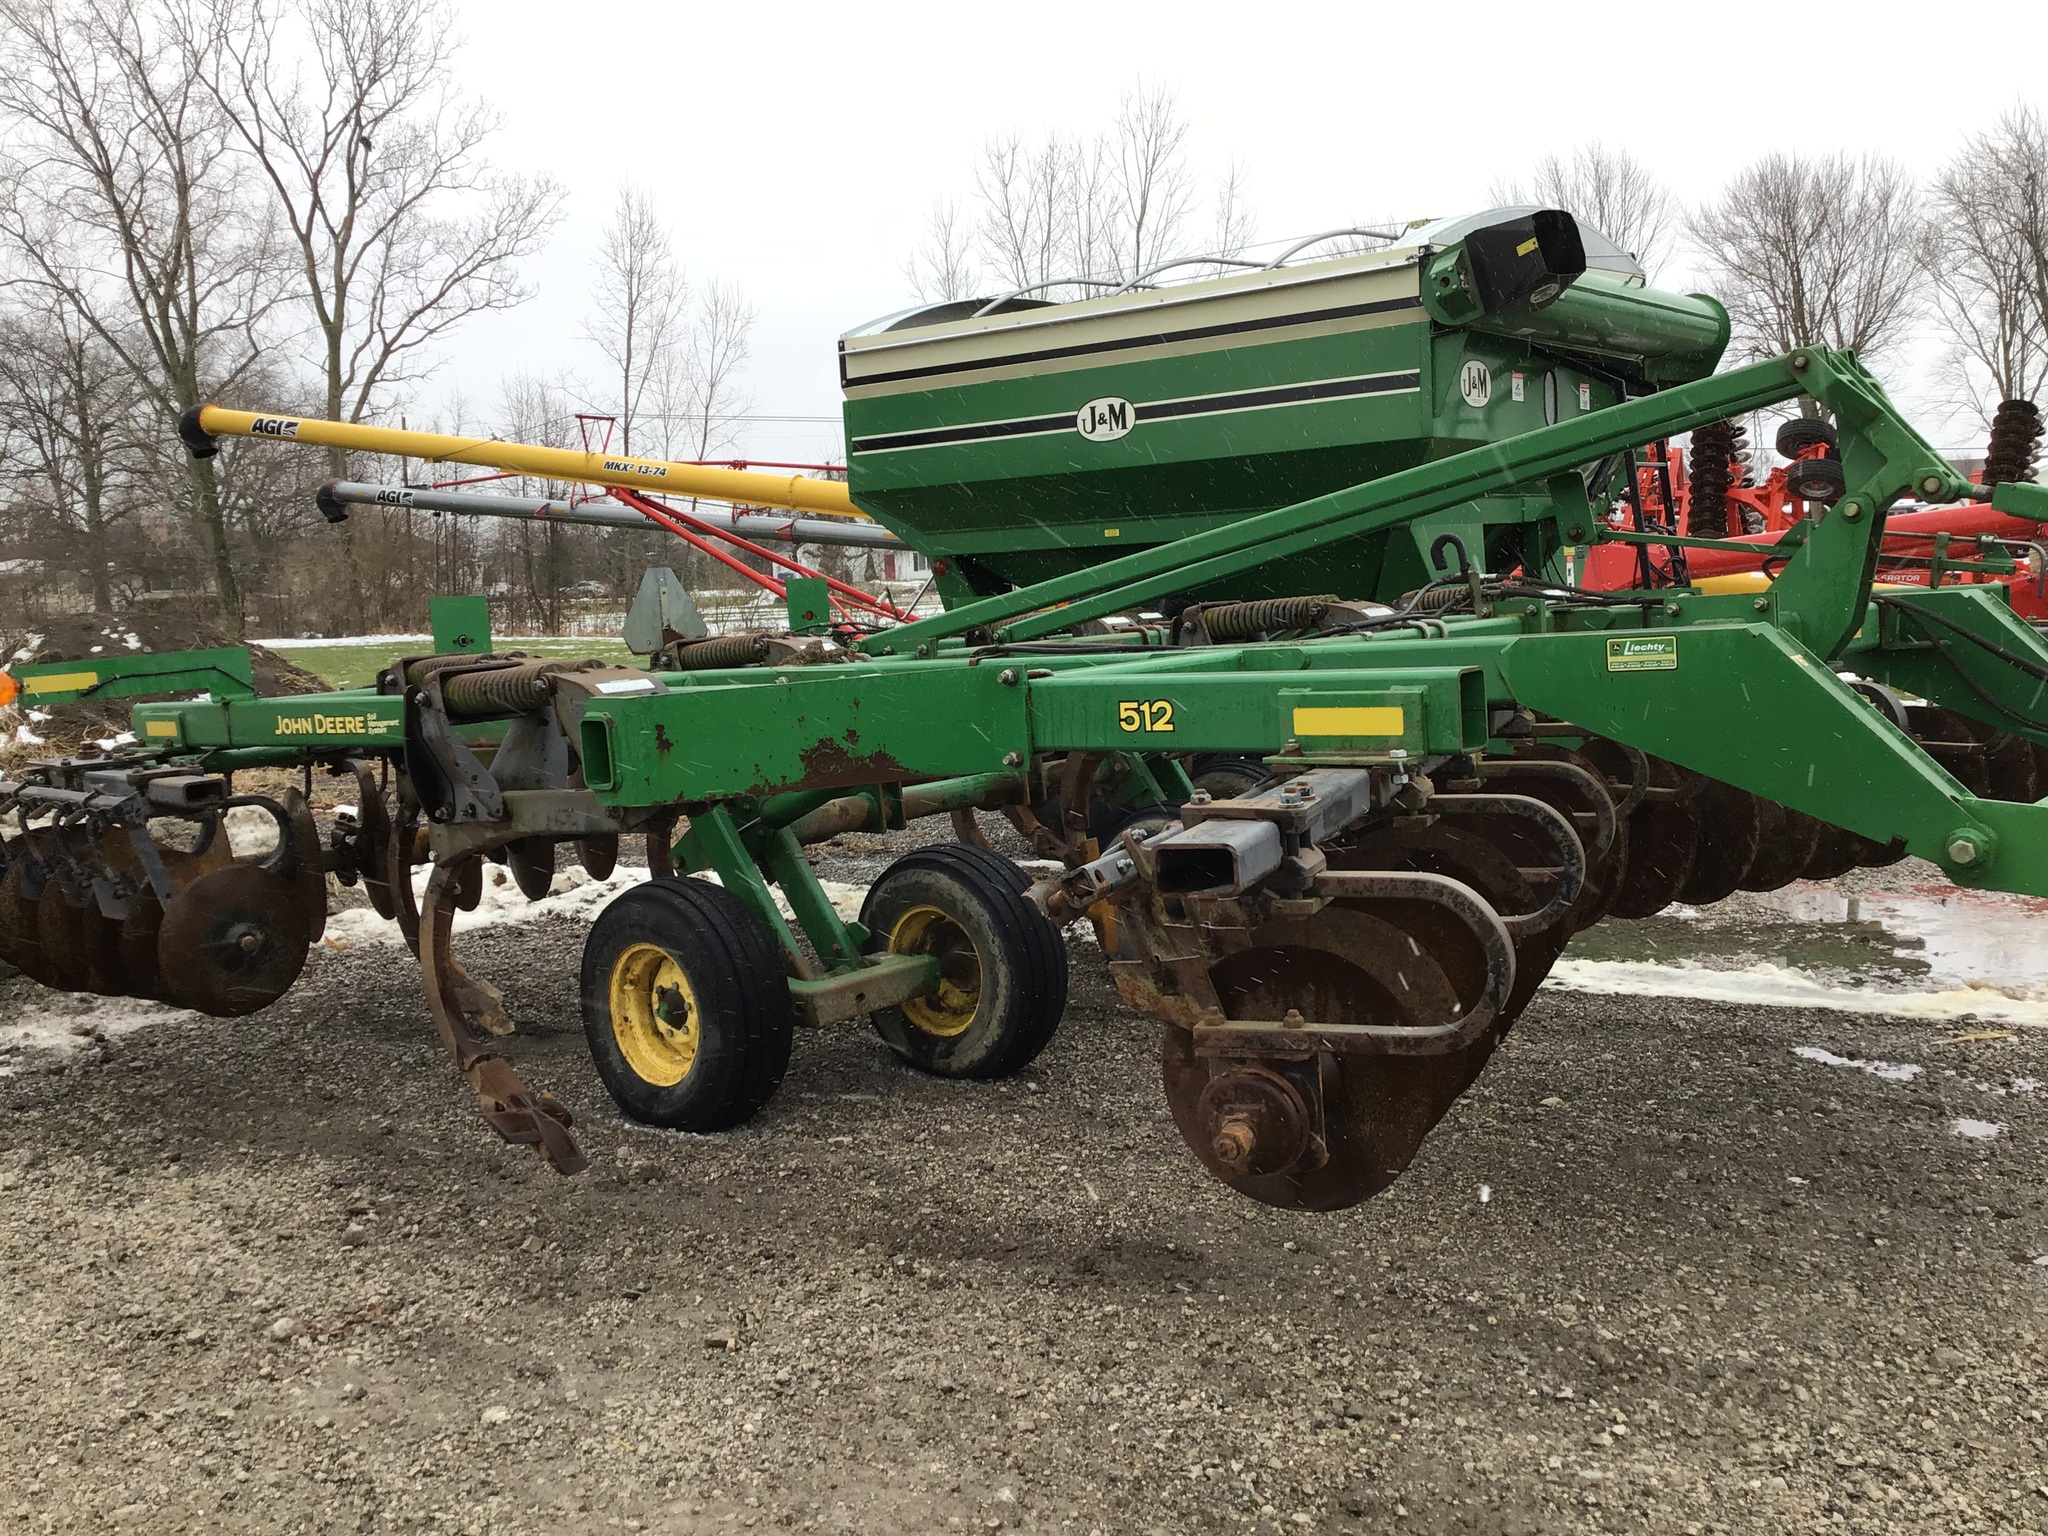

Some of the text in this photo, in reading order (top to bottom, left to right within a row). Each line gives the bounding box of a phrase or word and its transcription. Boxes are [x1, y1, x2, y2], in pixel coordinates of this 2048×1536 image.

[1463, 366, 1488, 398] J&M
[251, 417, 285, 436] AGI
[1081, 401, 1129, 435] J&M
[637, 465, 667, 477] 13-74
[376, 489, 402, 504] AGI
[1623, 641, 1665, 656] Liechty
[275, 713, 366, 735] JOHN DEERE
[1118, 699, 1175, 733] 512
